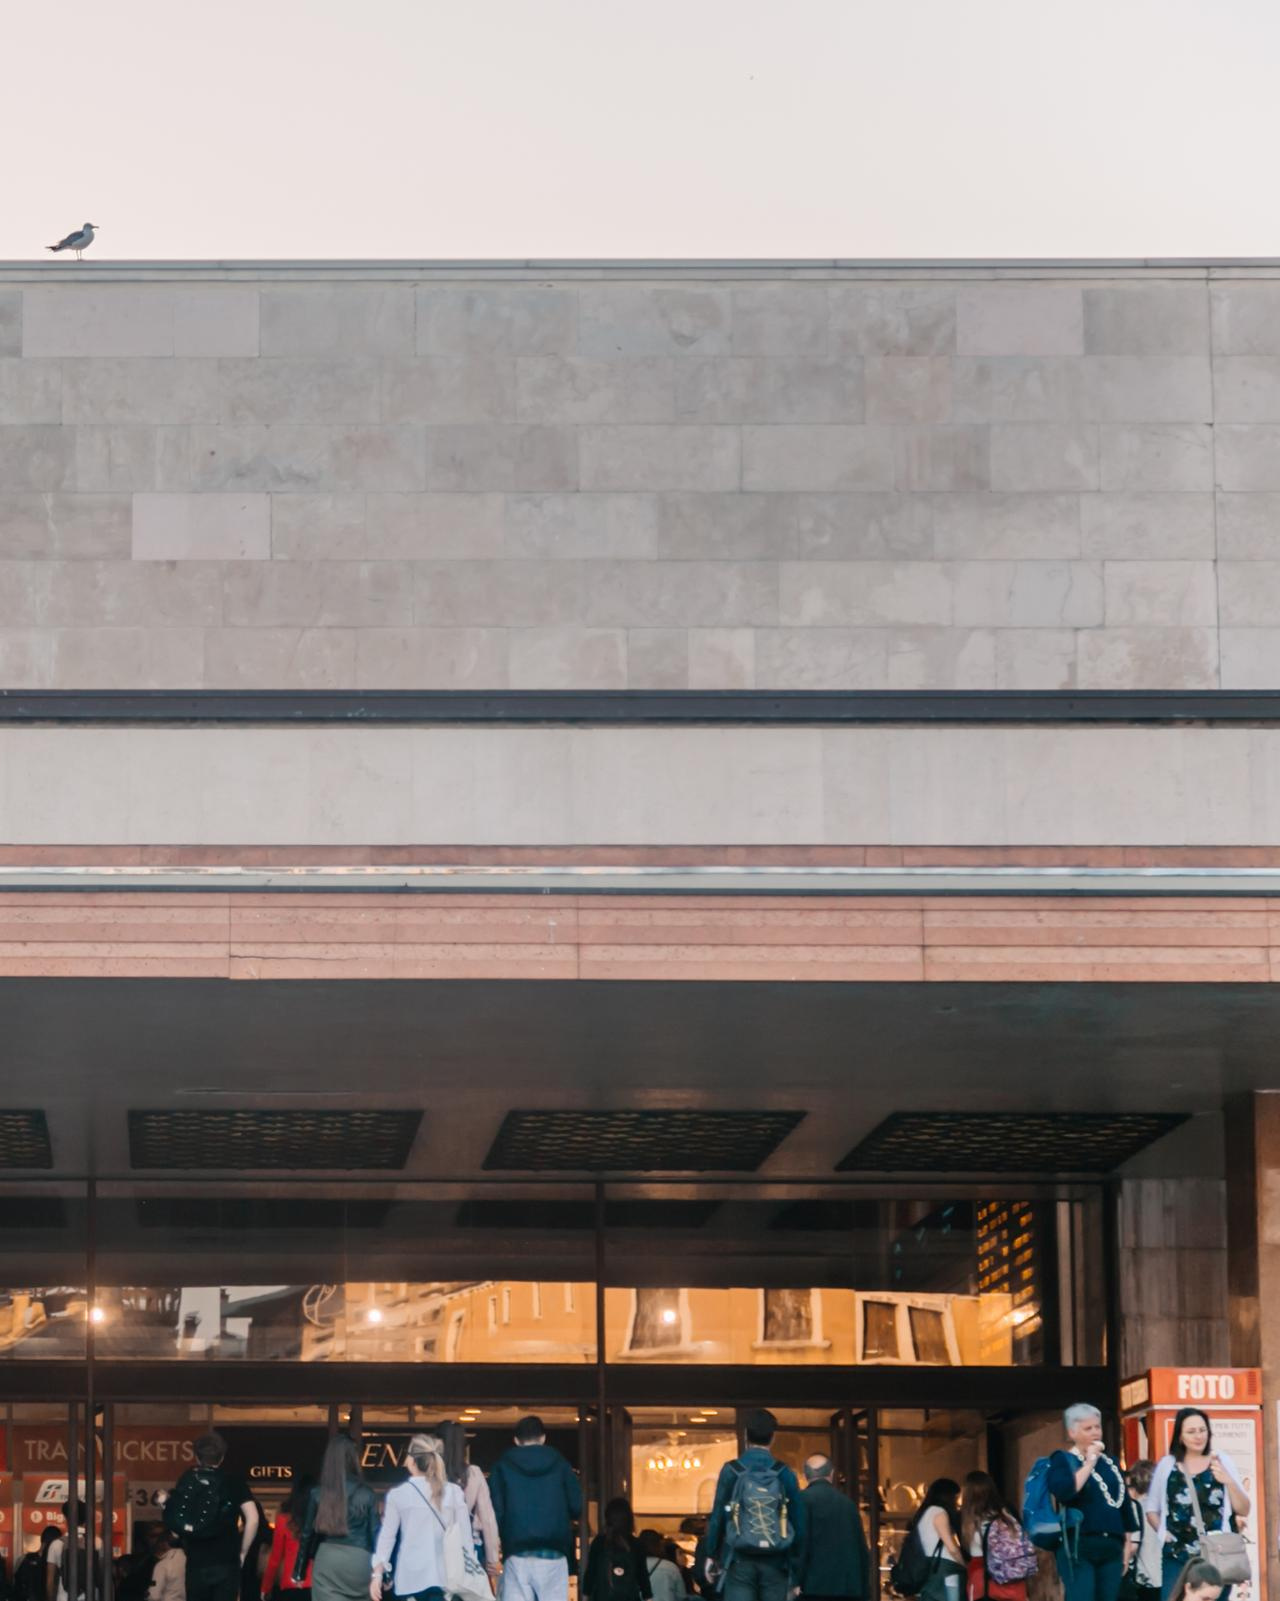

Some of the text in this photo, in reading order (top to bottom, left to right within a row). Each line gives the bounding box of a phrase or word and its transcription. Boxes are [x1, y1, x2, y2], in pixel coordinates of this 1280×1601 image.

[1178, 1374, 1235, 1400] FOTO
[113, 1440, 193, 1461] ICKETS
[250, 1466, 292, 1478] GIFTS
